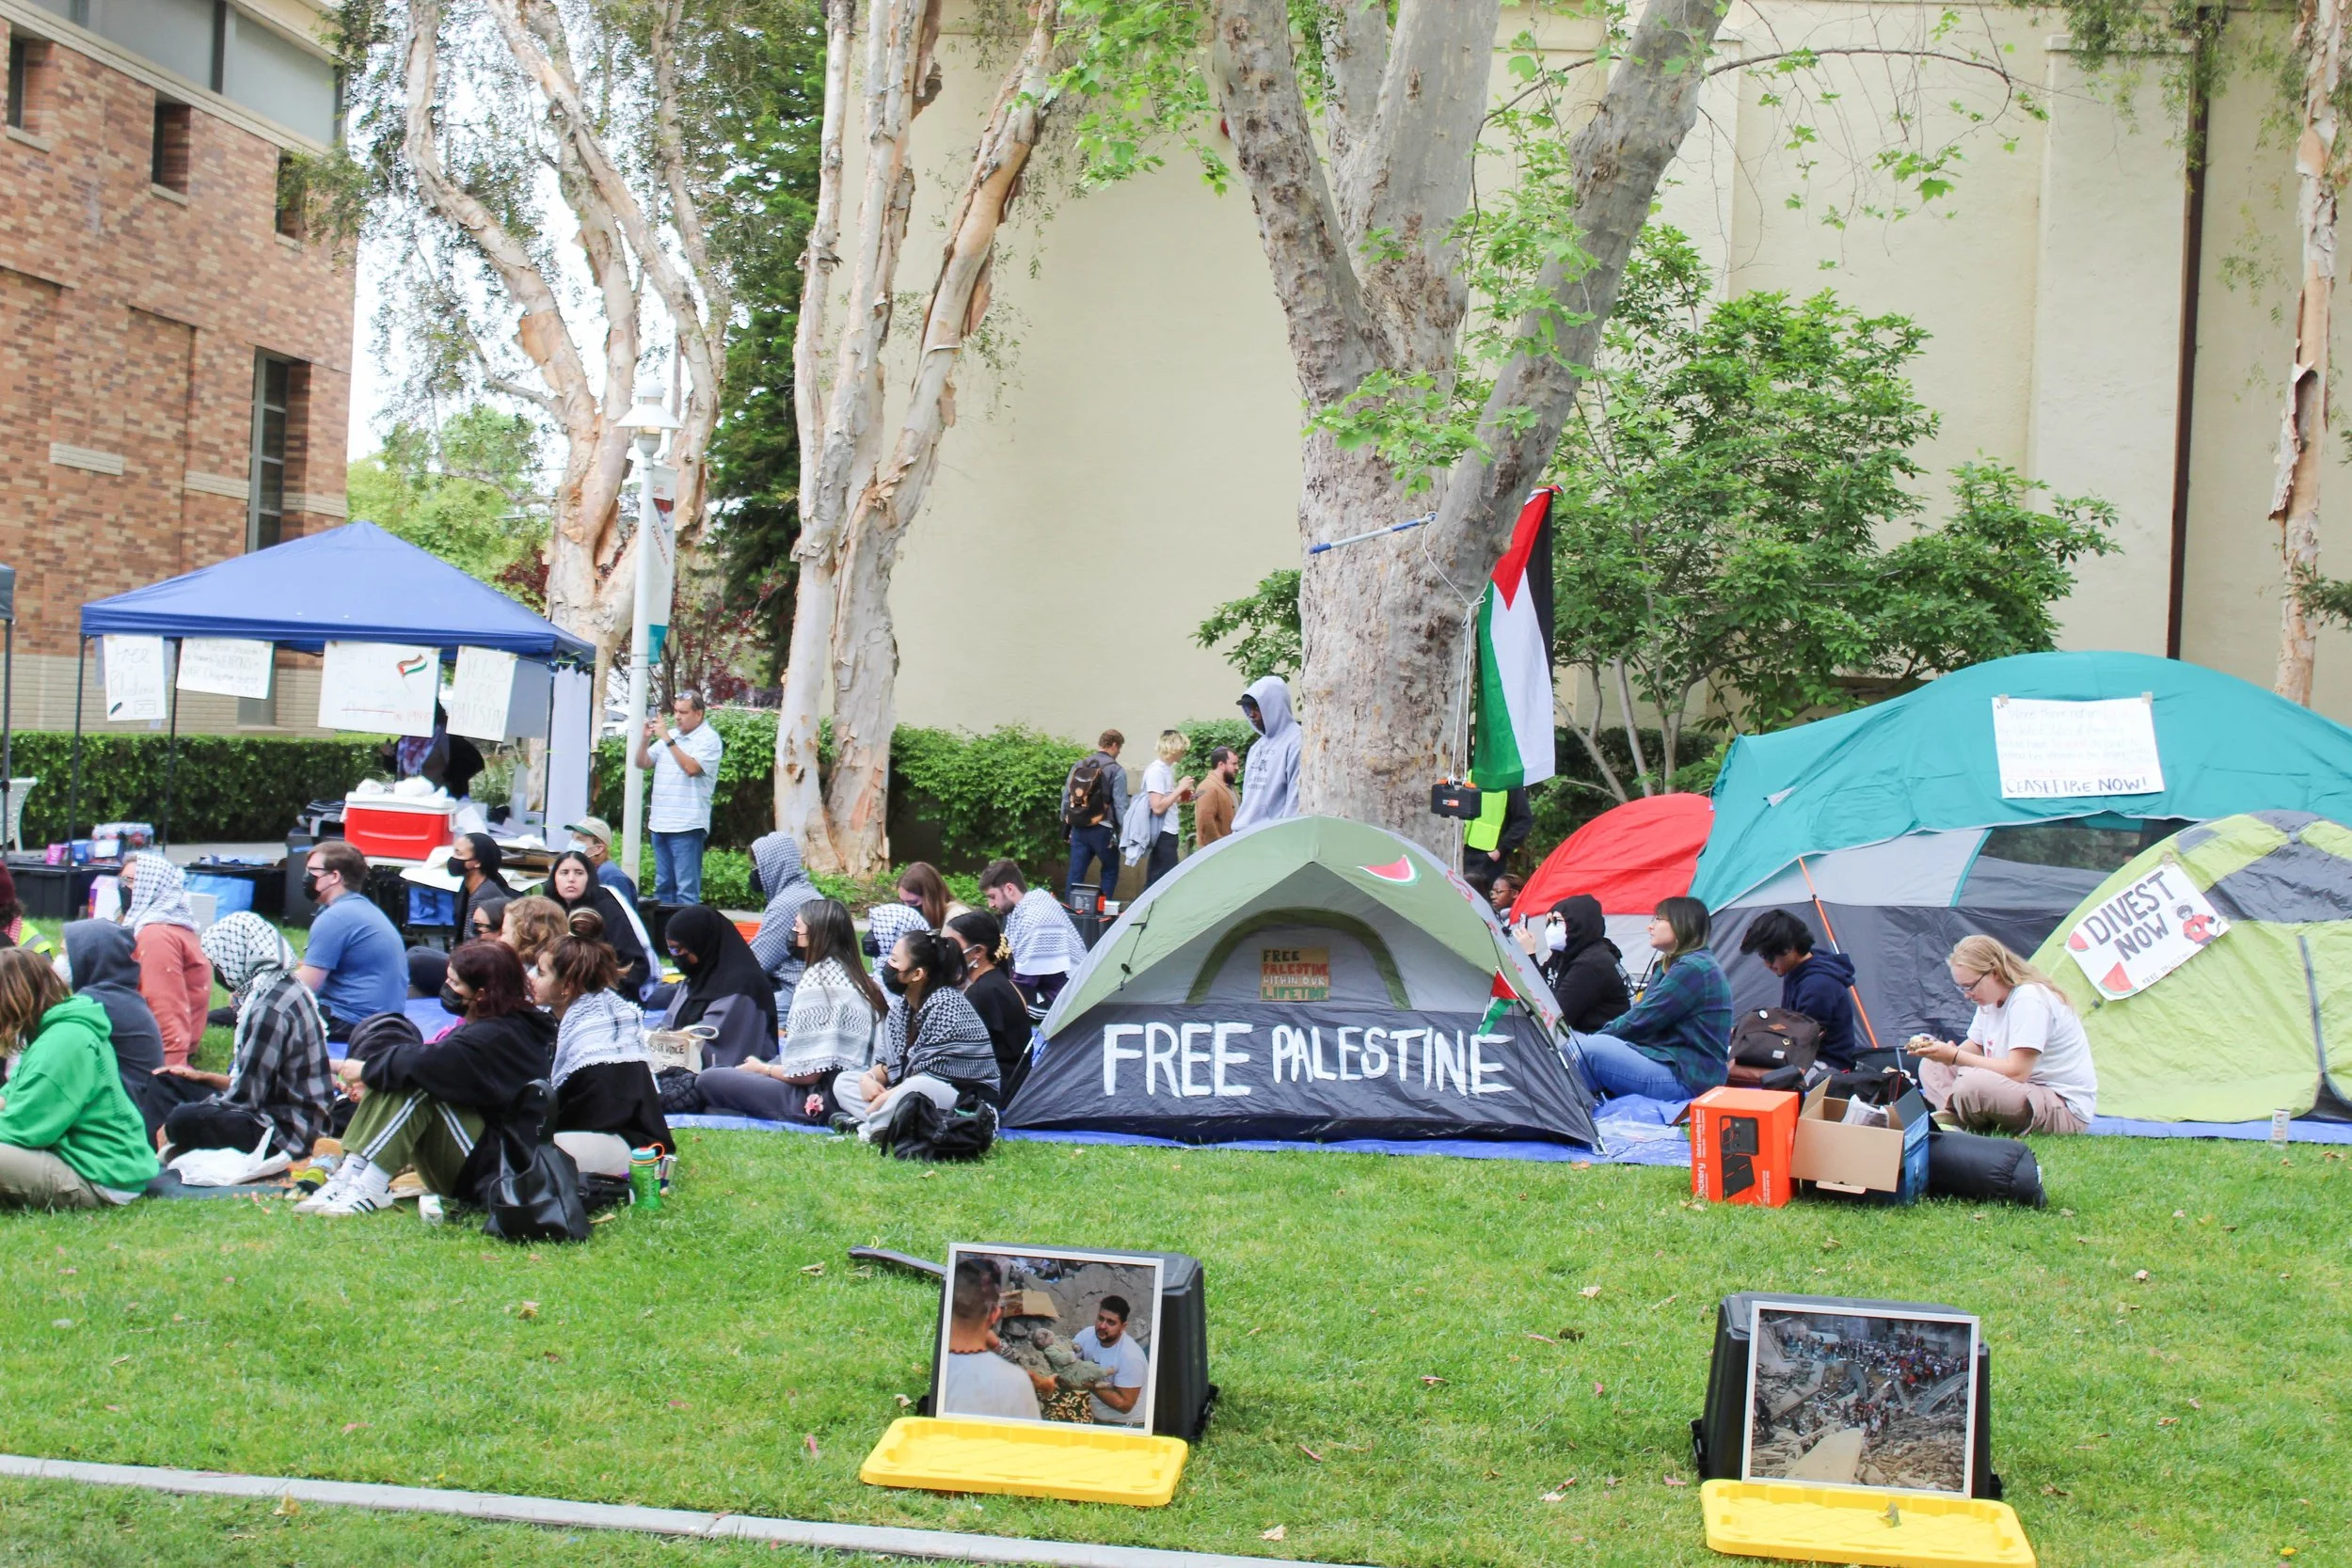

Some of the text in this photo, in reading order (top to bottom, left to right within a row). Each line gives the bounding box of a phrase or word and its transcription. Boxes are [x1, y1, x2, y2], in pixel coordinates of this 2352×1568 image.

[2006, 777, 2150, 794] CEASEFIRE NOW!
[2083, 870, 2174, 945] DIVEST
[2113, 912, 2169, 961] NOW
[1263, 949, 1300, 963] FREE
[1263, 962, 1328, 975] PALESTINE
[1263, 975, 1326, 987] WITHIN OUR
[1262, 986, 1328, 1000] LIFETIME
[1104, 1022, 1516, 1098] FREE PALESTINE
